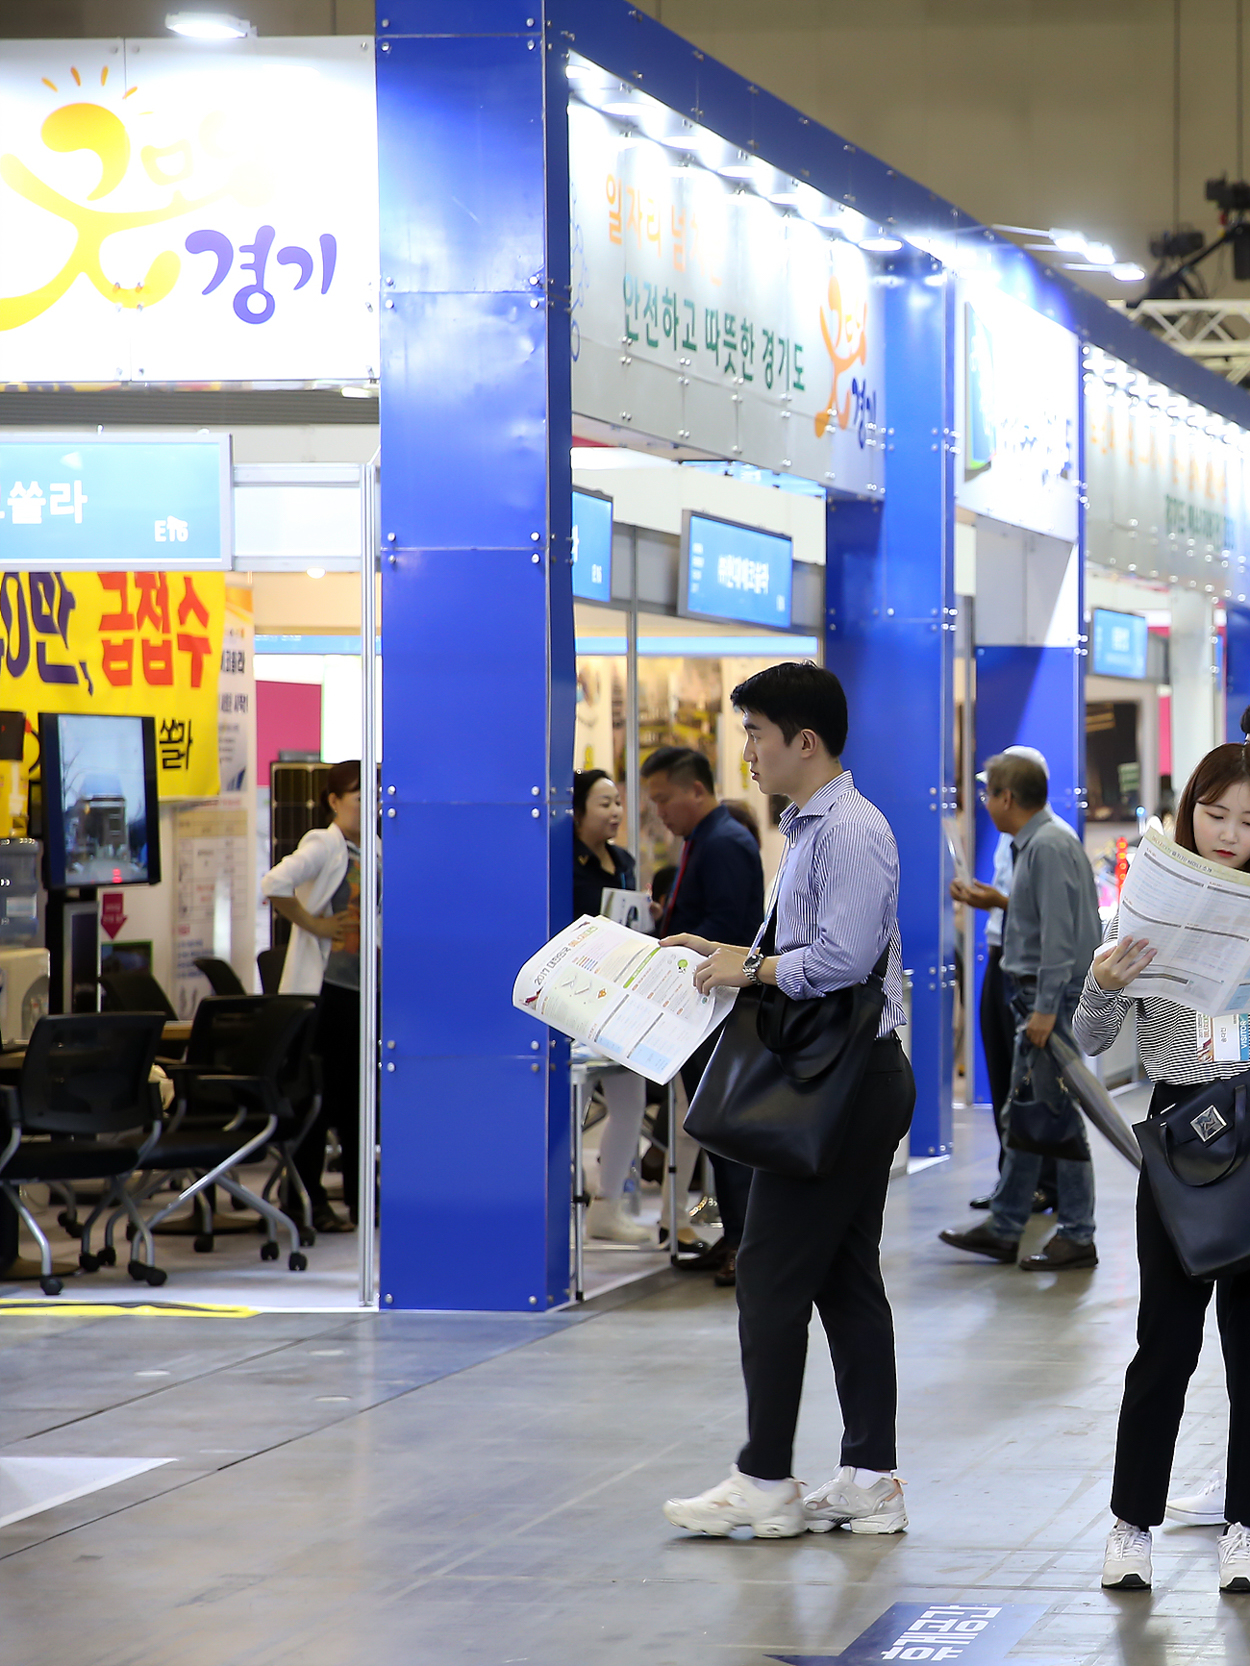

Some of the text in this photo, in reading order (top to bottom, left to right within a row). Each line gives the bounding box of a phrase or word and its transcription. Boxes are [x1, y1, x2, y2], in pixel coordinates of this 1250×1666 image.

[605, 173, 661, 258] 일자리
[185, 225, 337, 324] 경기
[623, 274, 805, 391] 안전하고 따뜻한 경기도
[0, 480, 88, 524] 쏠라
[534, 967, 550, 986] 2017
[1240, 1020, 1248, 1049] VISITOR
[881, 1604, 1003, 1661] 휴게공간
